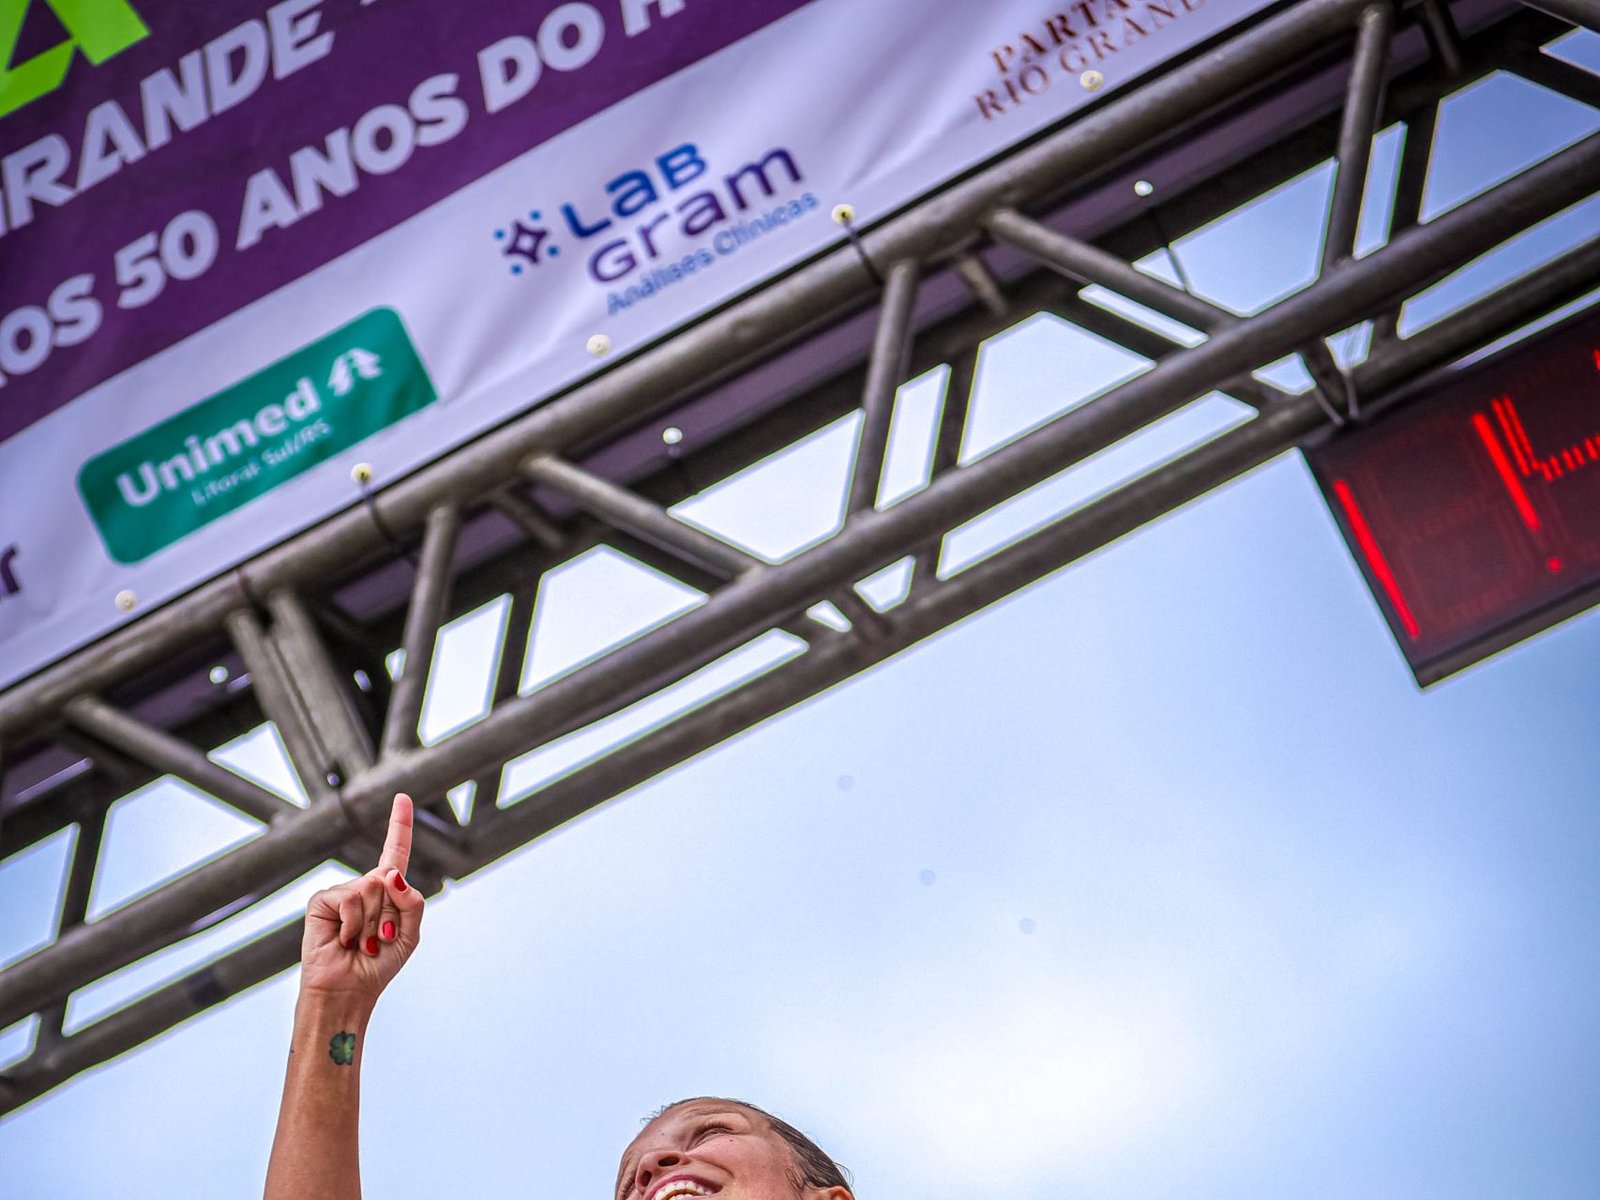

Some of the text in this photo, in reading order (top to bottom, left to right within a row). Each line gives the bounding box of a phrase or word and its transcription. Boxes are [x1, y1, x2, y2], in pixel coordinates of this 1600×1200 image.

[0, 0, 335, 238] RANDE
[974, 64, 1048, 120] RIO
[0, 2, 606, 388] OS 50 ANOS DO
[586, 147, 803, 283] Gram
[115, 376, 322, 508] Unimed
[190, 460, 263, 507] Litoral
